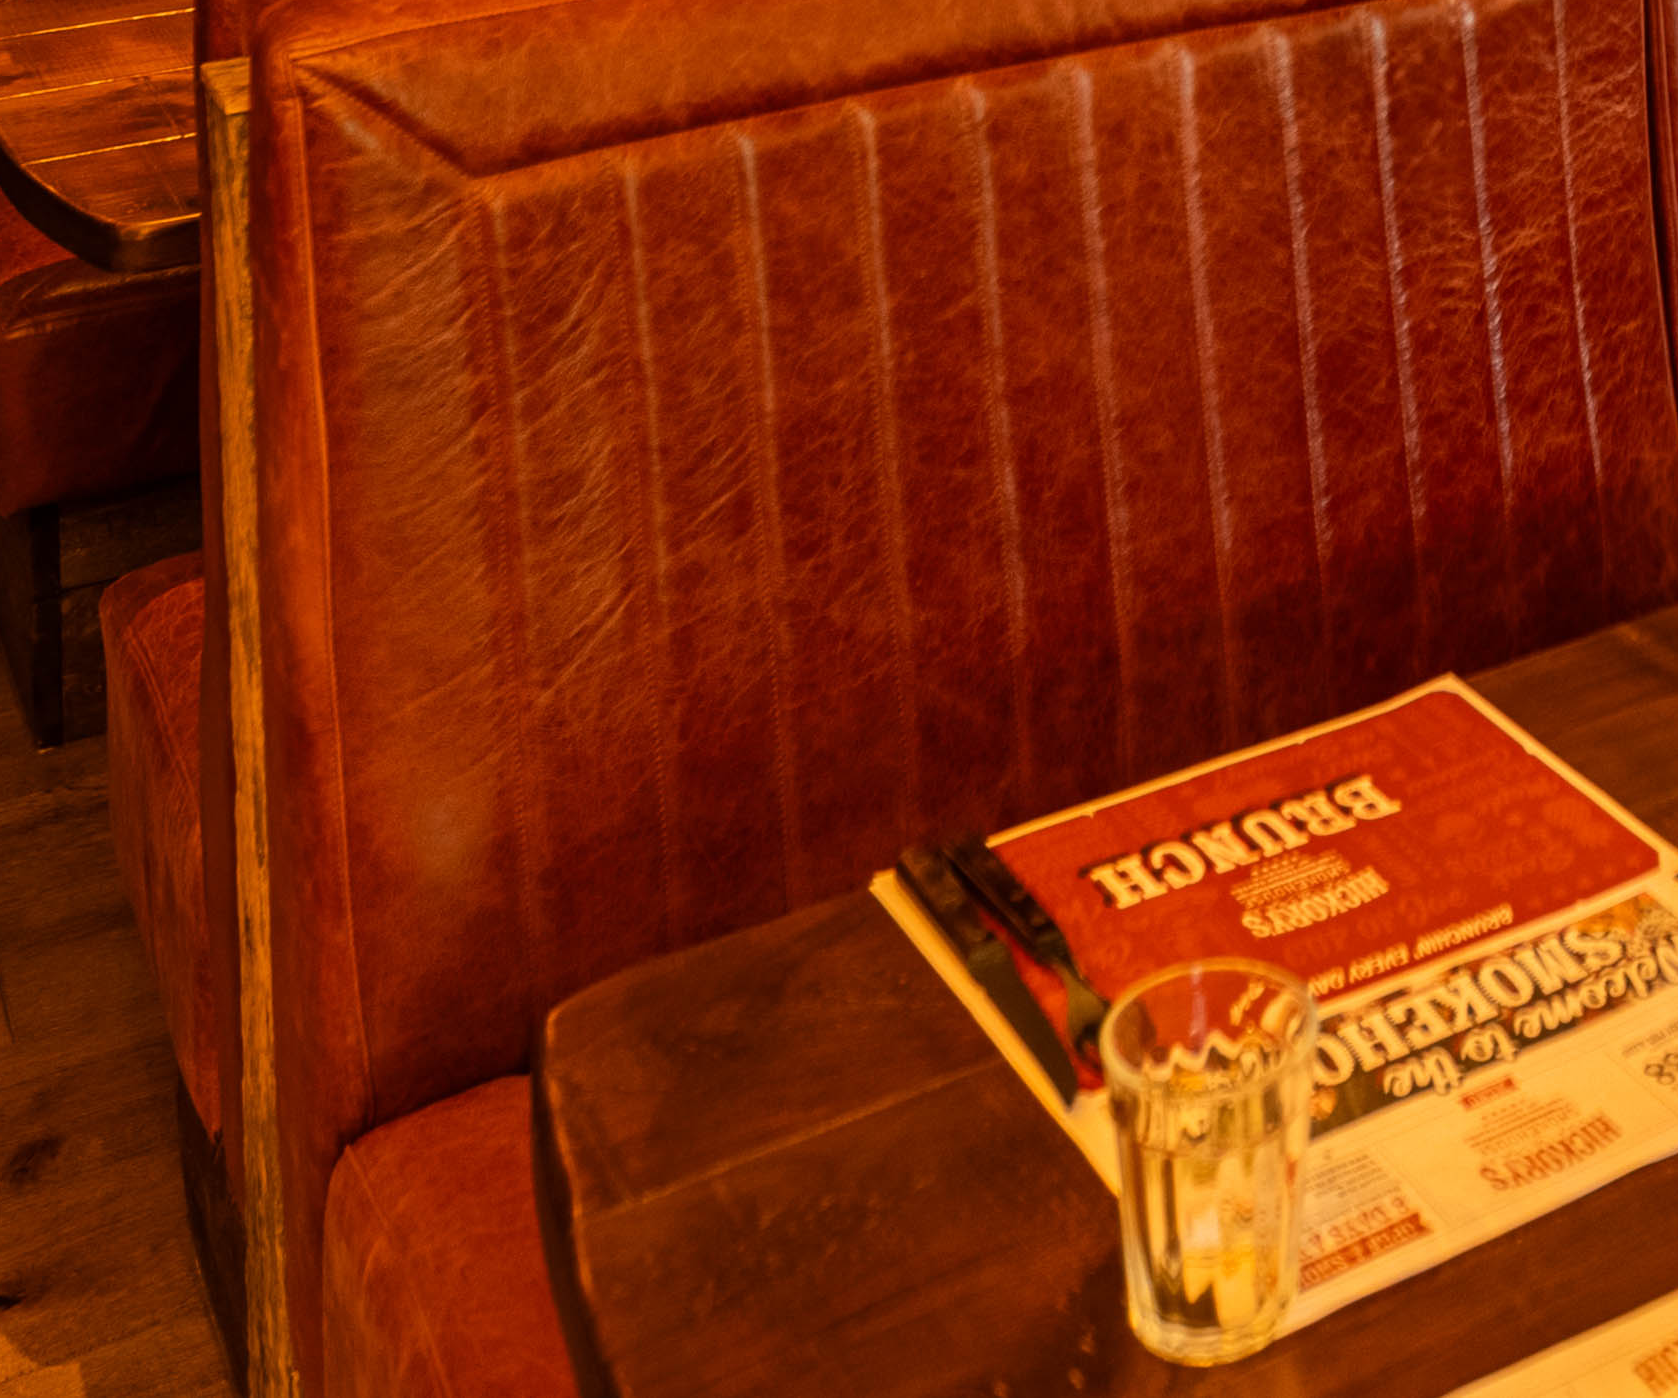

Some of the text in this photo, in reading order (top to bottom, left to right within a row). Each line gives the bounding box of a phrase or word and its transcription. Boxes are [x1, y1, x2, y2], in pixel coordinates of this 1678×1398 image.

[1089, 774, 1401, 910] BRUNCH
[1242, 866, 1389, 938] HICKORY'S
[1308, 902, 1514, 997] BRUNCHIN' EVERY DAY
[1310, 922, 1626, 1088] SMOKEHO
[1383, 1045, 1460, 1098] the
[1458, 1024, 1520, 1065] to
[1480, 1115, 1622, 1192] HICKORY'S
